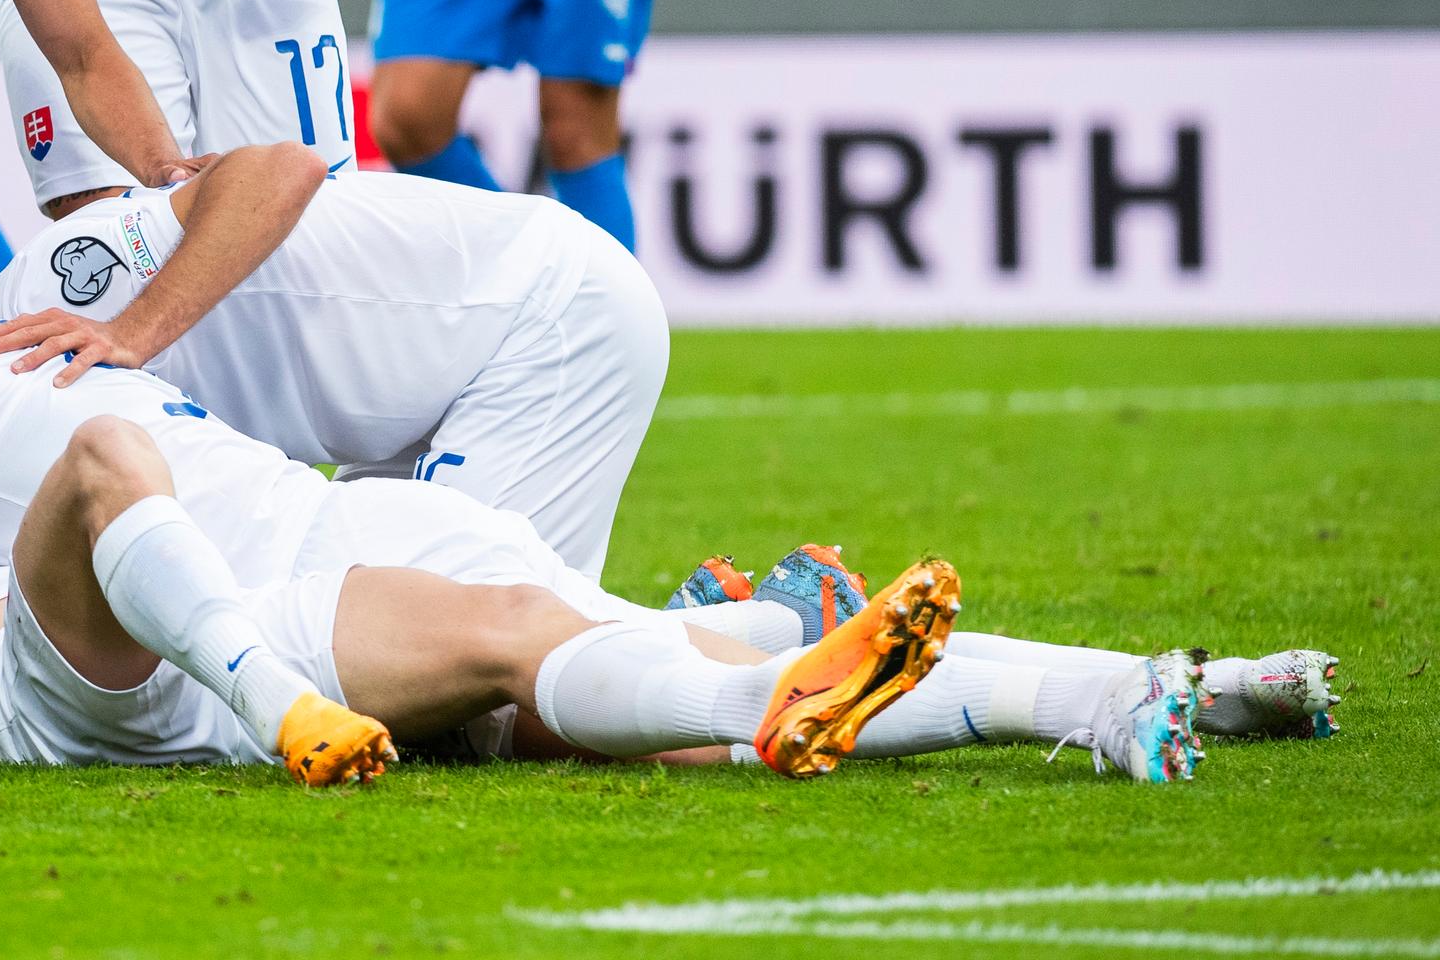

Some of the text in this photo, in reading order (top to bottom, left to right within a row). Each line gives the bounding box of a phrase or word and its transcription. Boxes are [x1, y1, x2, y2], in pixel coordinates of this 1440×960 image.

[275, 35, 349, 146] 17
[124, 213, 157, 277] FOUNDATIO
[624, 123, 1205, 276] ÜRTH
